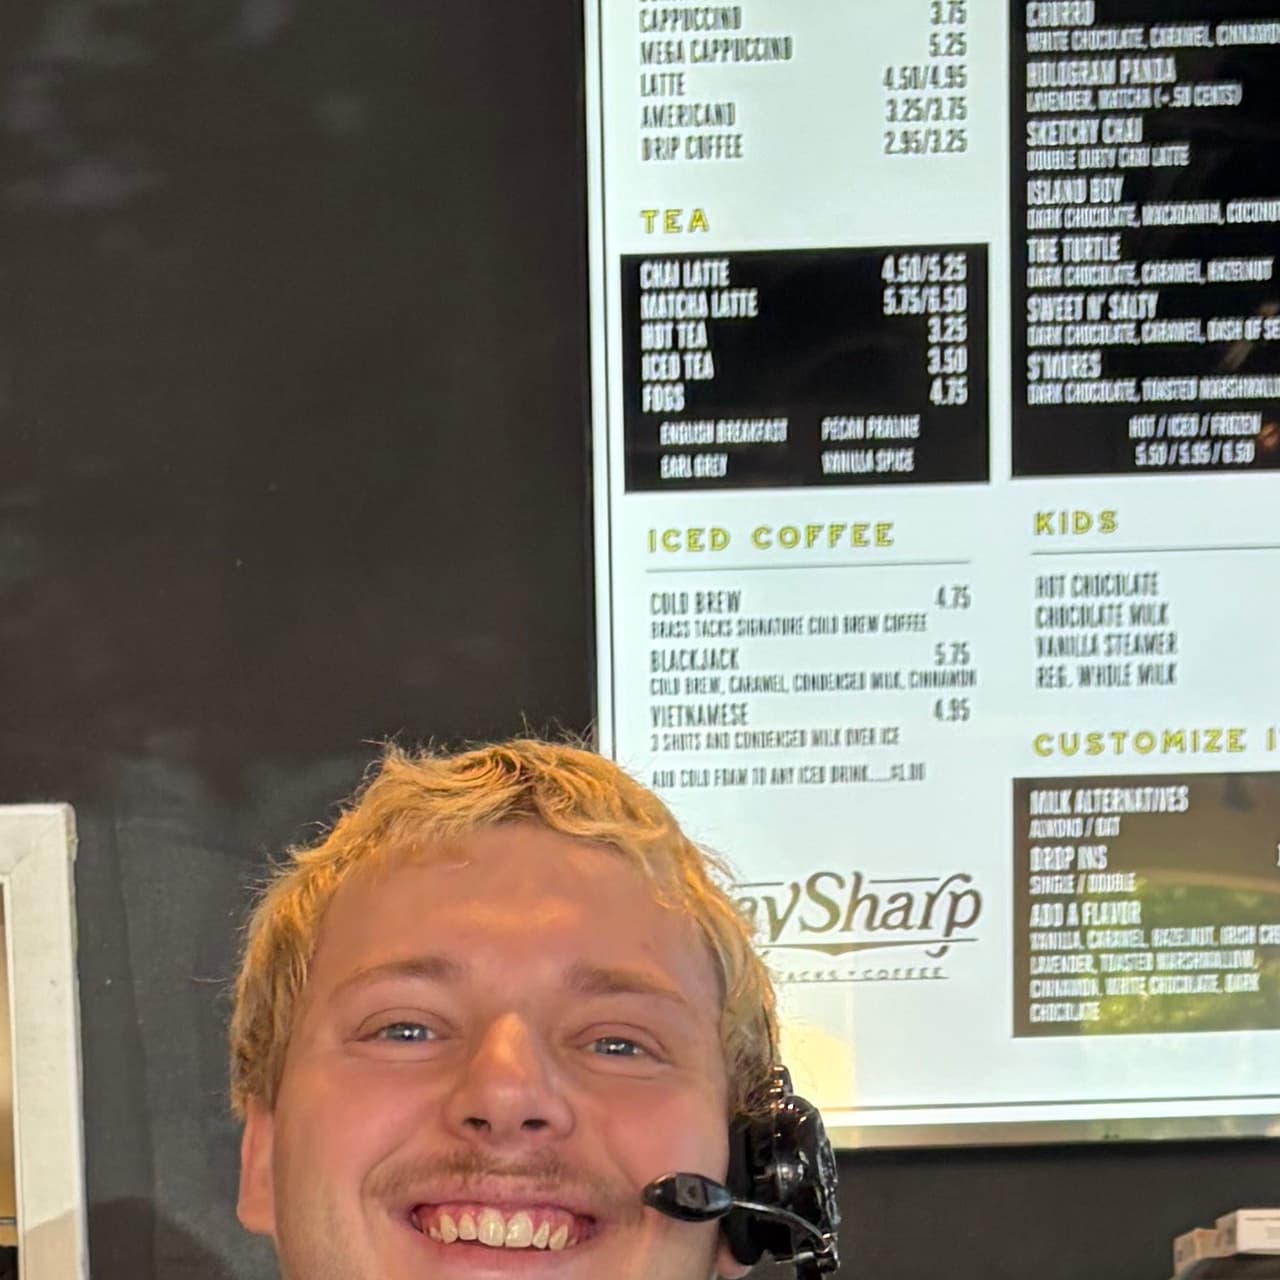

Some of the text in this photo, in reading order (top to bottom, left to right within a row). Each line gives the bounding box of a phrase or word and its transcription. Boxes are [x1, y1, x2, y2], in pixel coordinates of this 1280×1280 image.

[930, 32, 967, 57] 5.25
[641, 72, 684, 97] LATTE
[642, 97, 967, 128] AMERICANO 3.25/3.75
[643, 129, 967, 161] DRIP COFFEE 2.95/3.25
[640, 208, 709, 234] TEA
[649, 523, 894, 552] ICED COFFEE
[1034, 511, 1118, 535] KIDS
[651, 585, 970, 615] COLD BREW 4.75
[651, 642, 970, 672] BLACKJACK 5.75
[651, 698, 970, 727] VIETNAMESE 4.95
[1033, 729, 1246, 756] CUSTOMIZE
